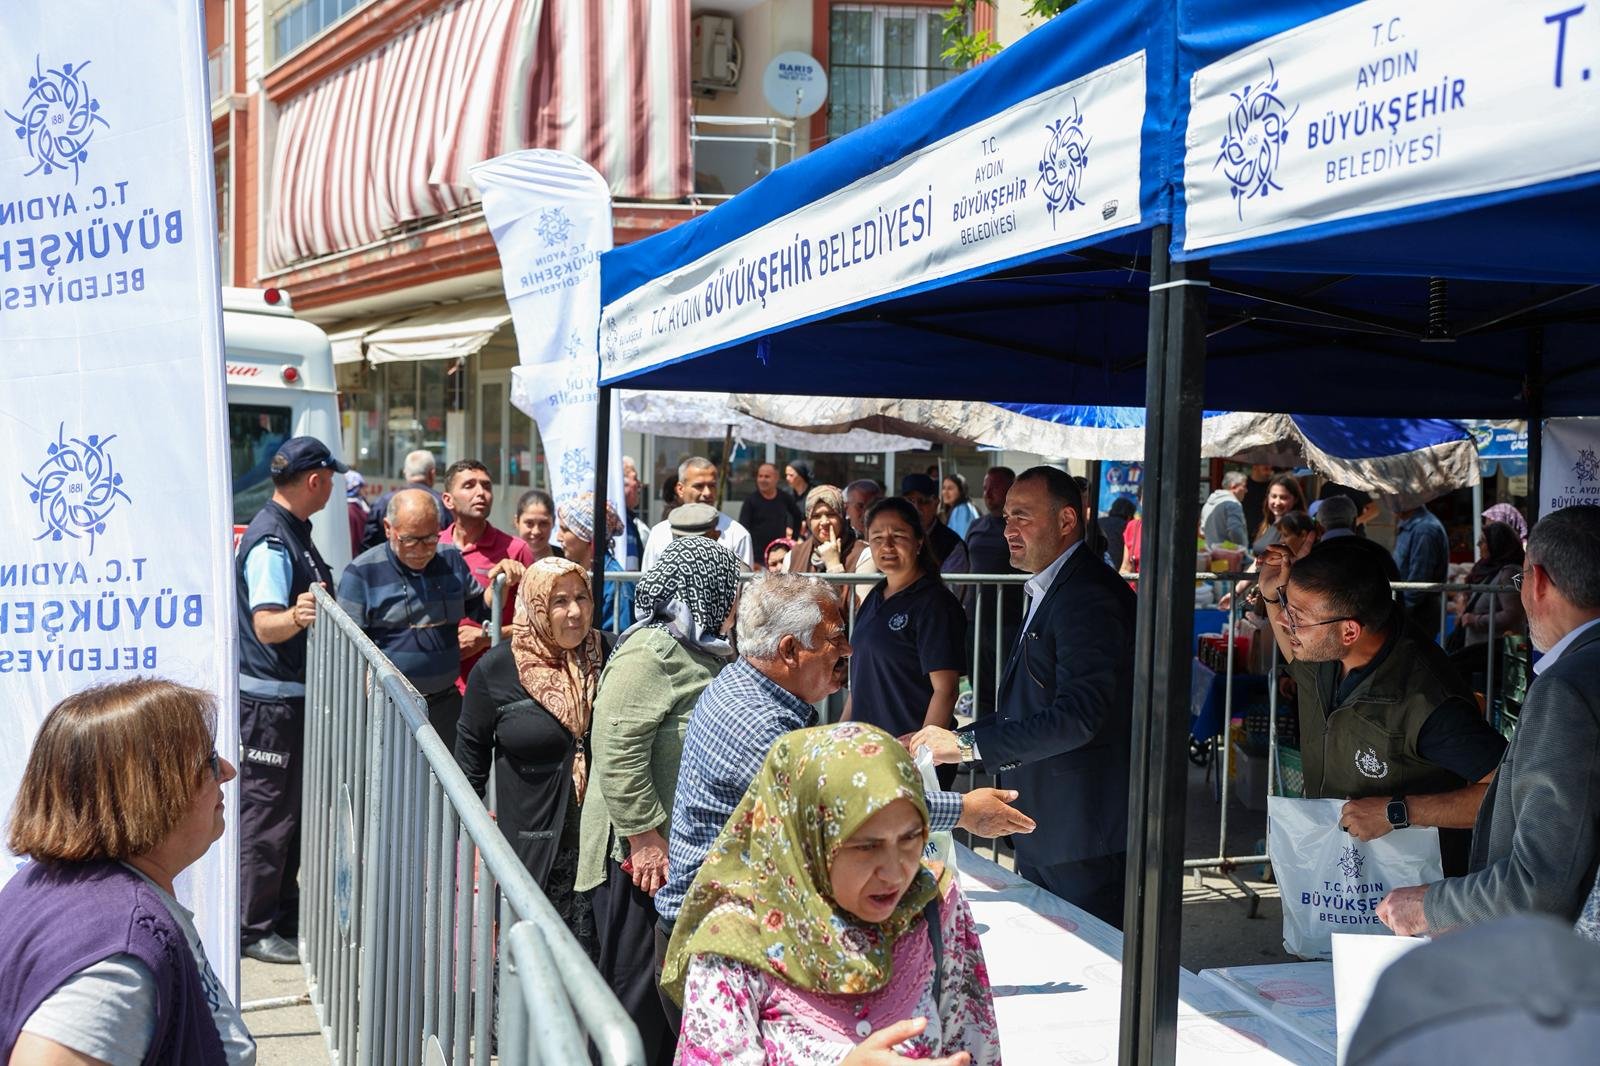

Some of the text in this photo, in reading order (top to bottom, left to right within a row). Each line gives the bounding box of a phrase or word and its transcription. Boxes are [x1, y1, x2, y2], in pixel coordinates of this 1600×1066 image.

[1371, 17, 1405, 47] T.C.
[1356, 49, 1418, 91] AYDIN
[1307, 76, 1466, 150] BÜYÜKŞEHİR
[981, 136, 1000, 156] T.C.
[1325, 127, 1443, 184] BELEDİYESİ
[974, 159, 1004, 185] AYDIN
[952, 176, 1028, 222] BÜYÜKŞEHİR
[960, 209, 1017, 246] BELEDİYESİ
[652, 306, 668, 337] T.C.
[668, 294, 702, 332] AYDIN
[704, 229, 813, 317] BÜYÜKŞEHİR
[819, 184, 933, 273] BELEDİYESİ
[1301, 891, 1384, 915] BÜYÜKŞE
[1324, 881, 1384, 895] T.C. AYDIN
[1319, 912, 1384, 925] BELEDİYE
